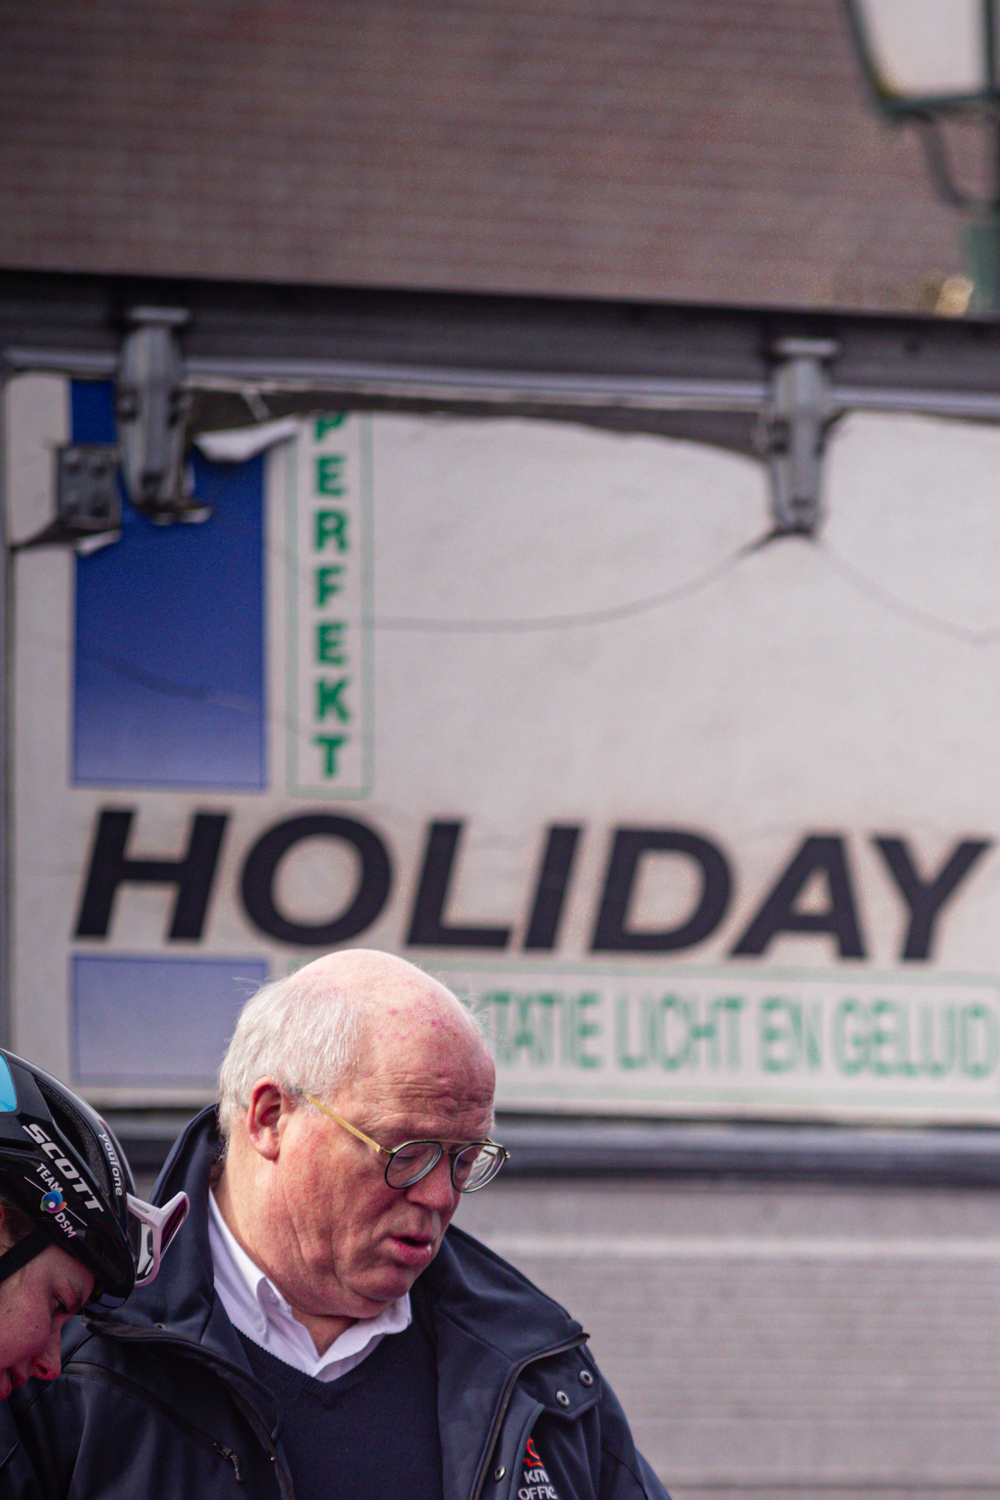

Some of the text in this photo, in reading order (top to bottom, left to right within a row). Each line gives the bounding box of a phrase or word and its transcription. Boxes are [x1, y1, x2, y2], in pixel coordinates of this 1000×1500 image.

[313, 412, 350, 780] PERFEKT
[71, 805, 993, 965] HOLIDAY
[759, 995, 827, 1075] EN
[22, 1123, 105, 1213] SCOTT
[35, 1163, 64, 1194] TEAM
[98, 1132, 123, 1197] youfone
[54, 1211, 77, 1238] DSM
